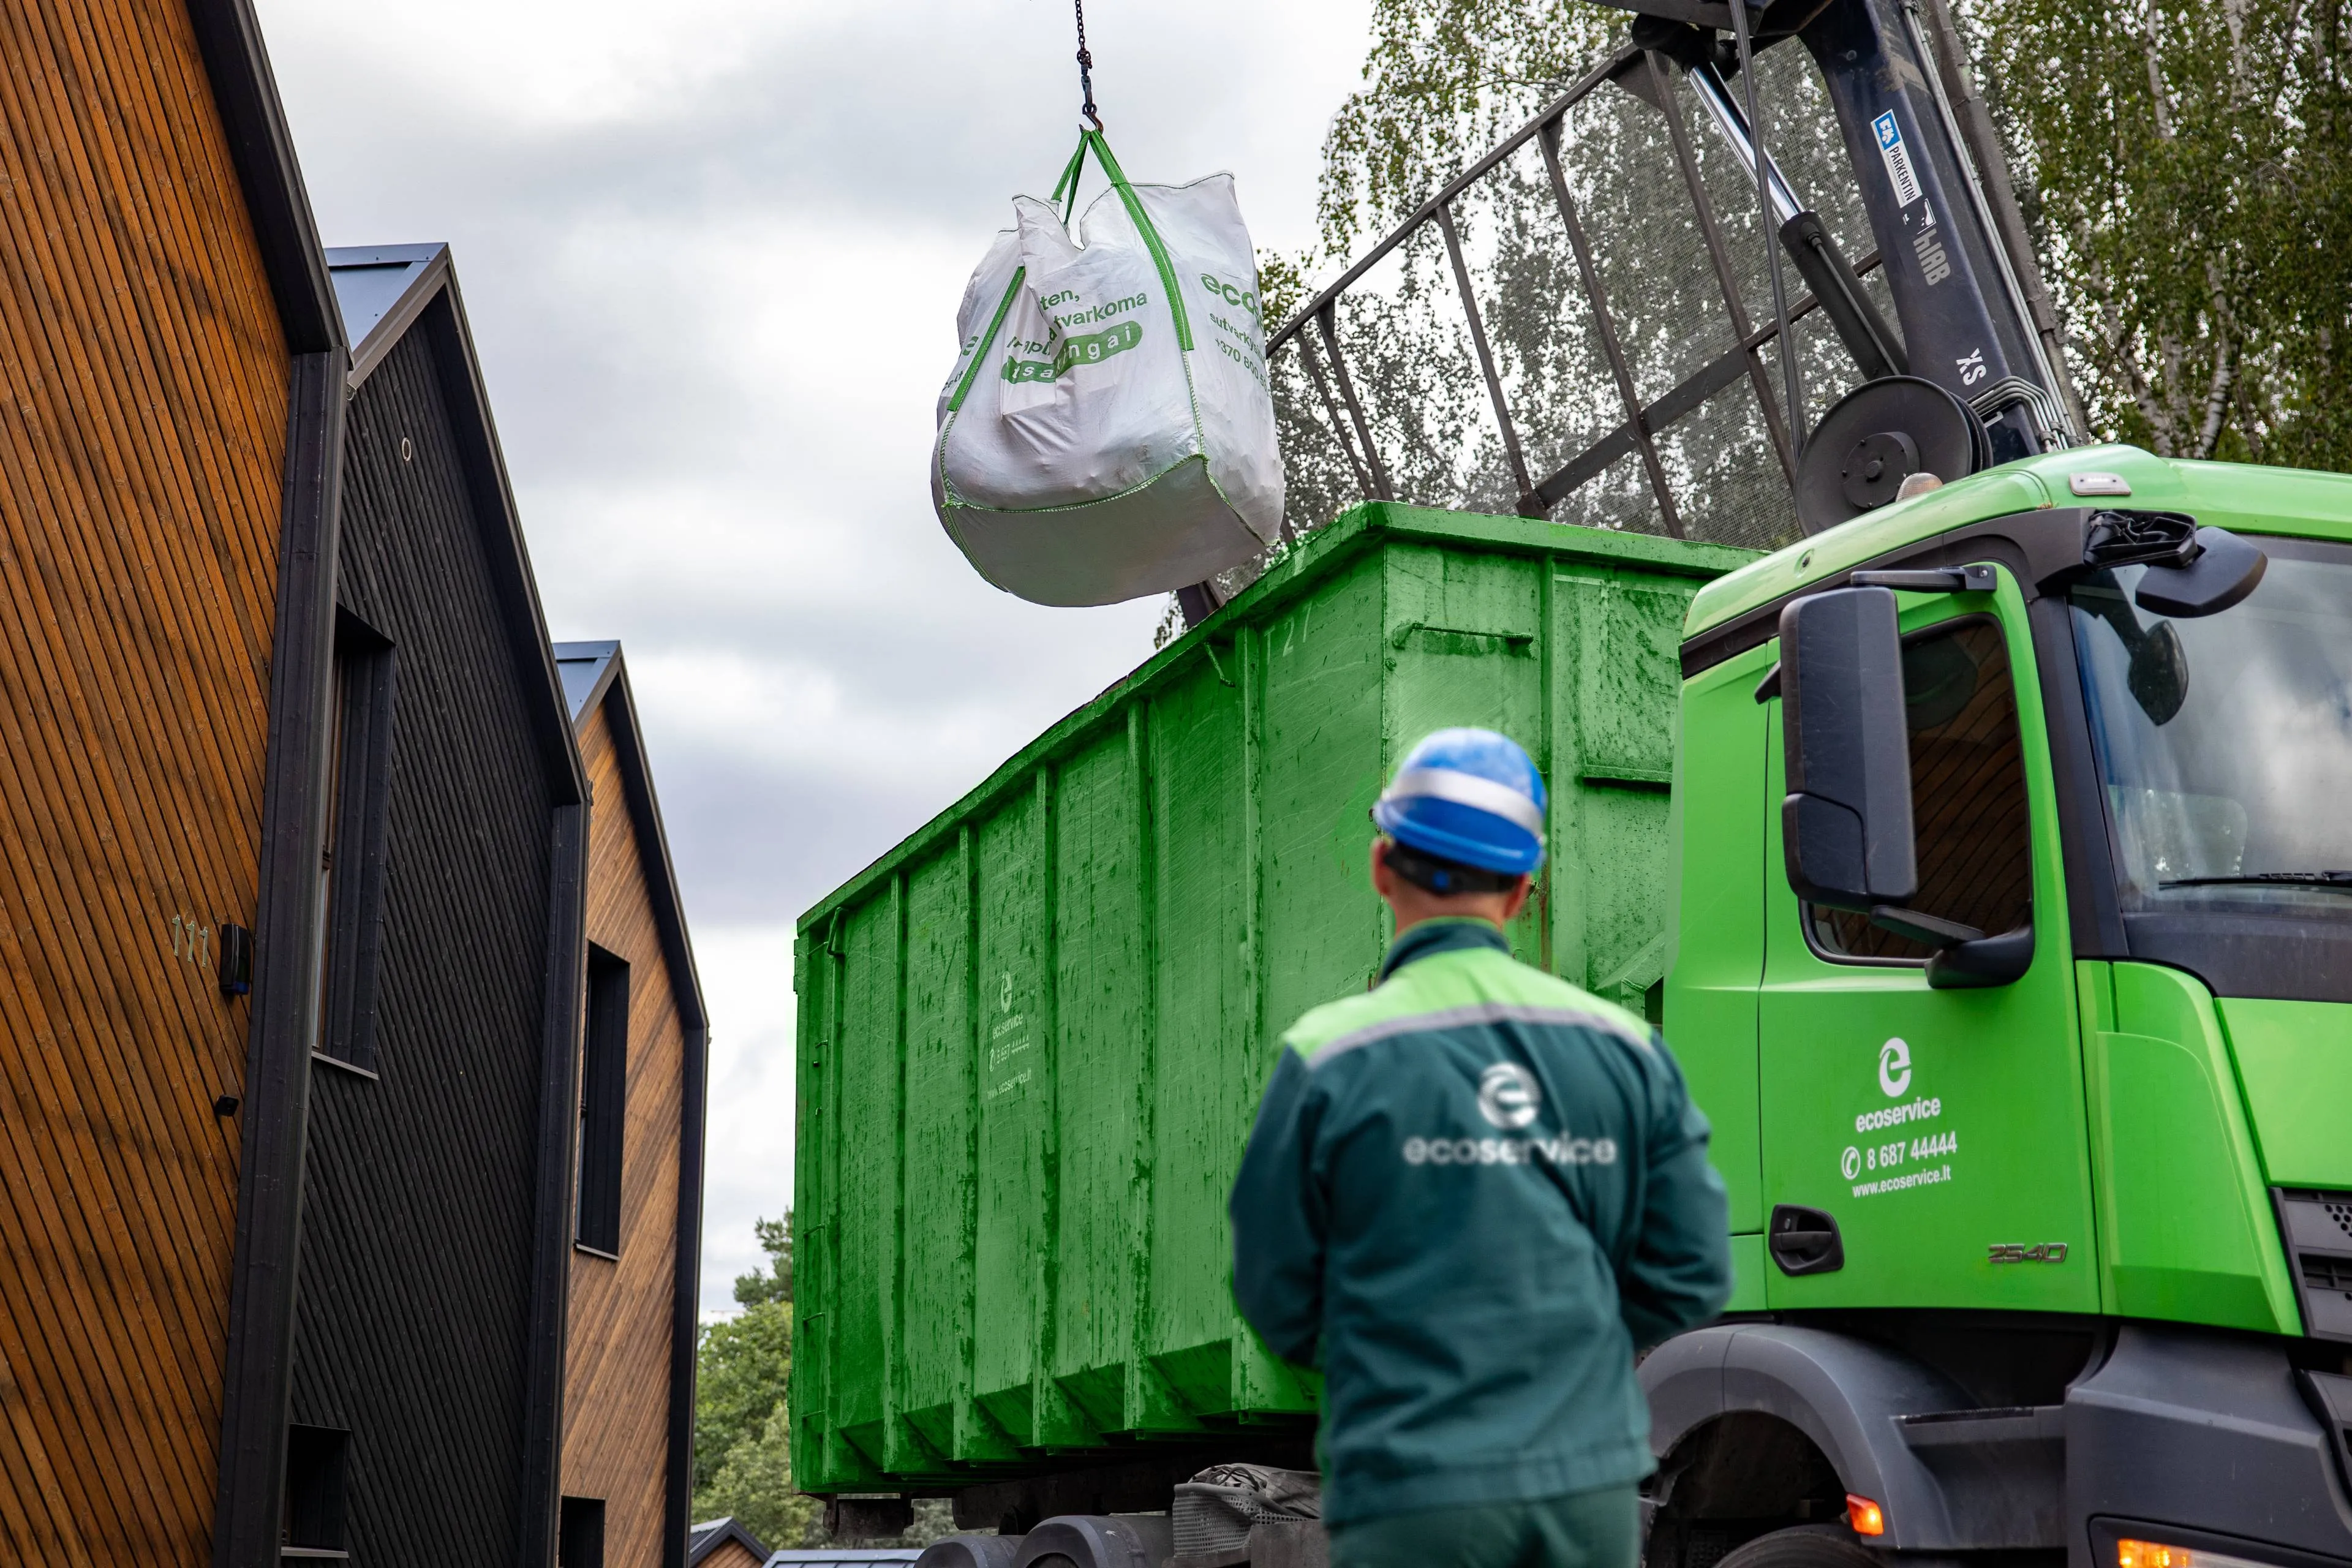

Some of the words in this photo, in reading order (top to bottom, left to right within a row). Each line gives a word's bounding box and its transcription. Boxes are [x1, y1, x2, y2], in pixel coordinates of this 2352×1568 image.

[1889, 146, 1916, 201] PARKENTIN
[1040, 289, 1080, 311] ten,
[1054, 293, 1148, 330] tvarkoma
[1006, 325, 1131, 379] tsakingai
[1215, 337, 1241, 363] +370
[1244, 356, 1259, 380] 800
[1956, 347, 1987, 386] XS
[172, 914, 208, 969] 111
[1856, 1096, 1941, 1133] ecoservice
[1867, 1147, 1876, 1170] 8
[1880, 1141, 1906, 1169] 687
[1910, 1131, 1958, 1161] 44444
[1852, 1164, 1951, 1199] www.ecoservice.lt
[1988, 1242, 2068, 1264] 2540
